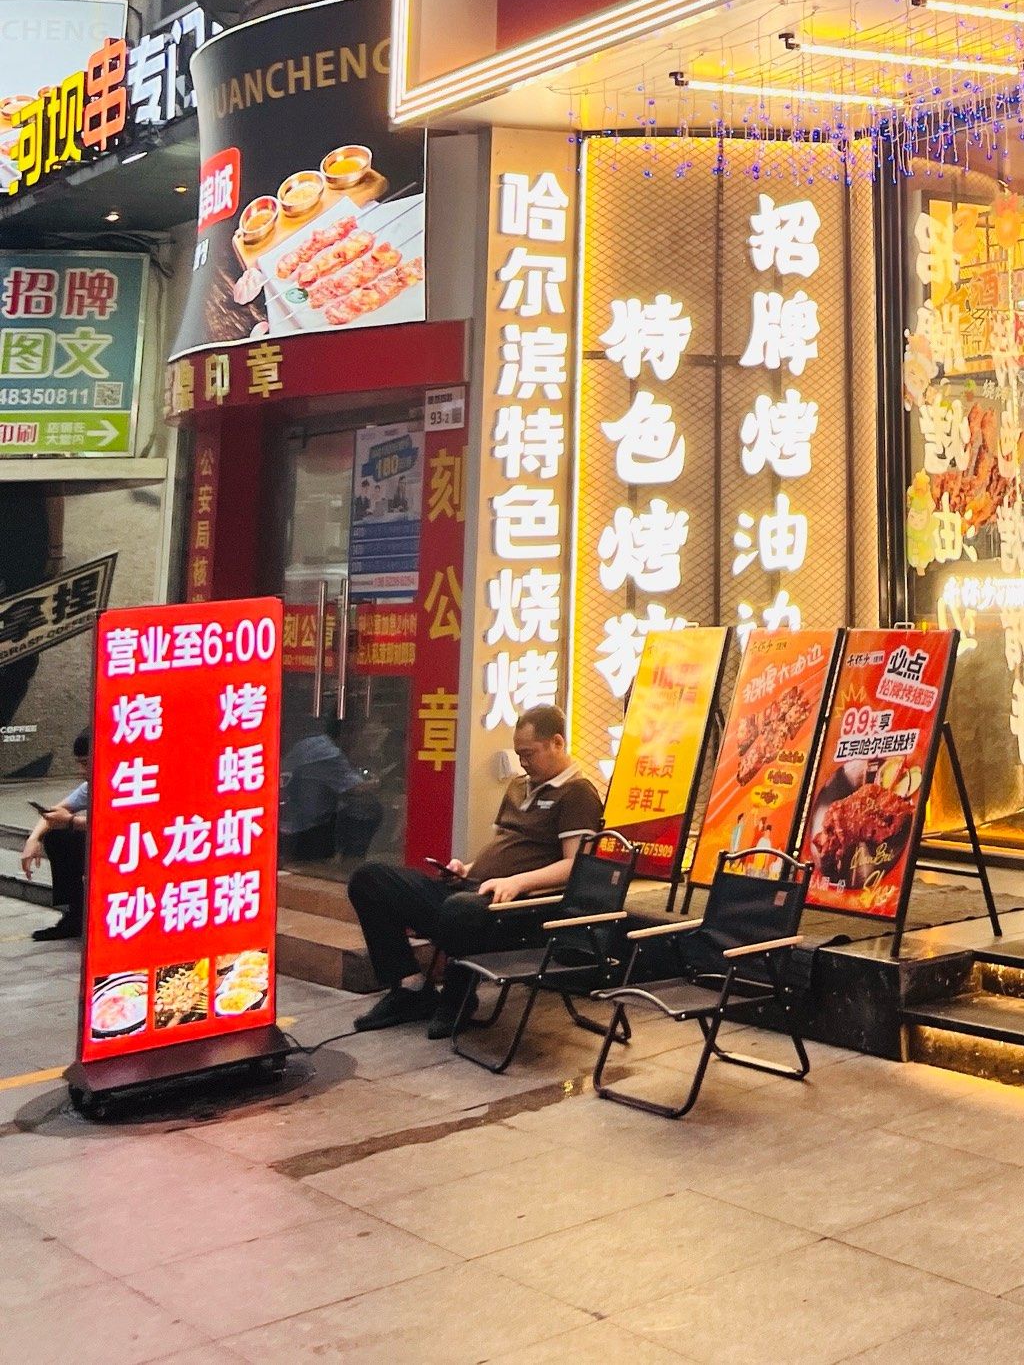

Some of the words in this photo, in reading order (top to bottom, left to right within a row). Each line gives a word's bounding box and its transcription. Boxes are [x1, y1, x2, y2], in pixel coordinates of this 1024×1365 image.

[4, 267, 118, 319] 招牌
[0, 327, 112, 379] 图文
[484, 172, 570, 732] 哈尔滨特色烧烤
[594, 294, 692, 781] 特色烤猪
[417, 445, 465, 771] 刻公章
[105, 617, 276, 677] 营业至6:00
[887, 648, 927, 681] 必点
[836, 733, 917, 759] 正宗哈尔滨烧烤
[626, 786, 669, 812] 穿串工
[108, 807, 264, 875] 小龙虾
[105, 870, 260, 941] 砂锅粥
